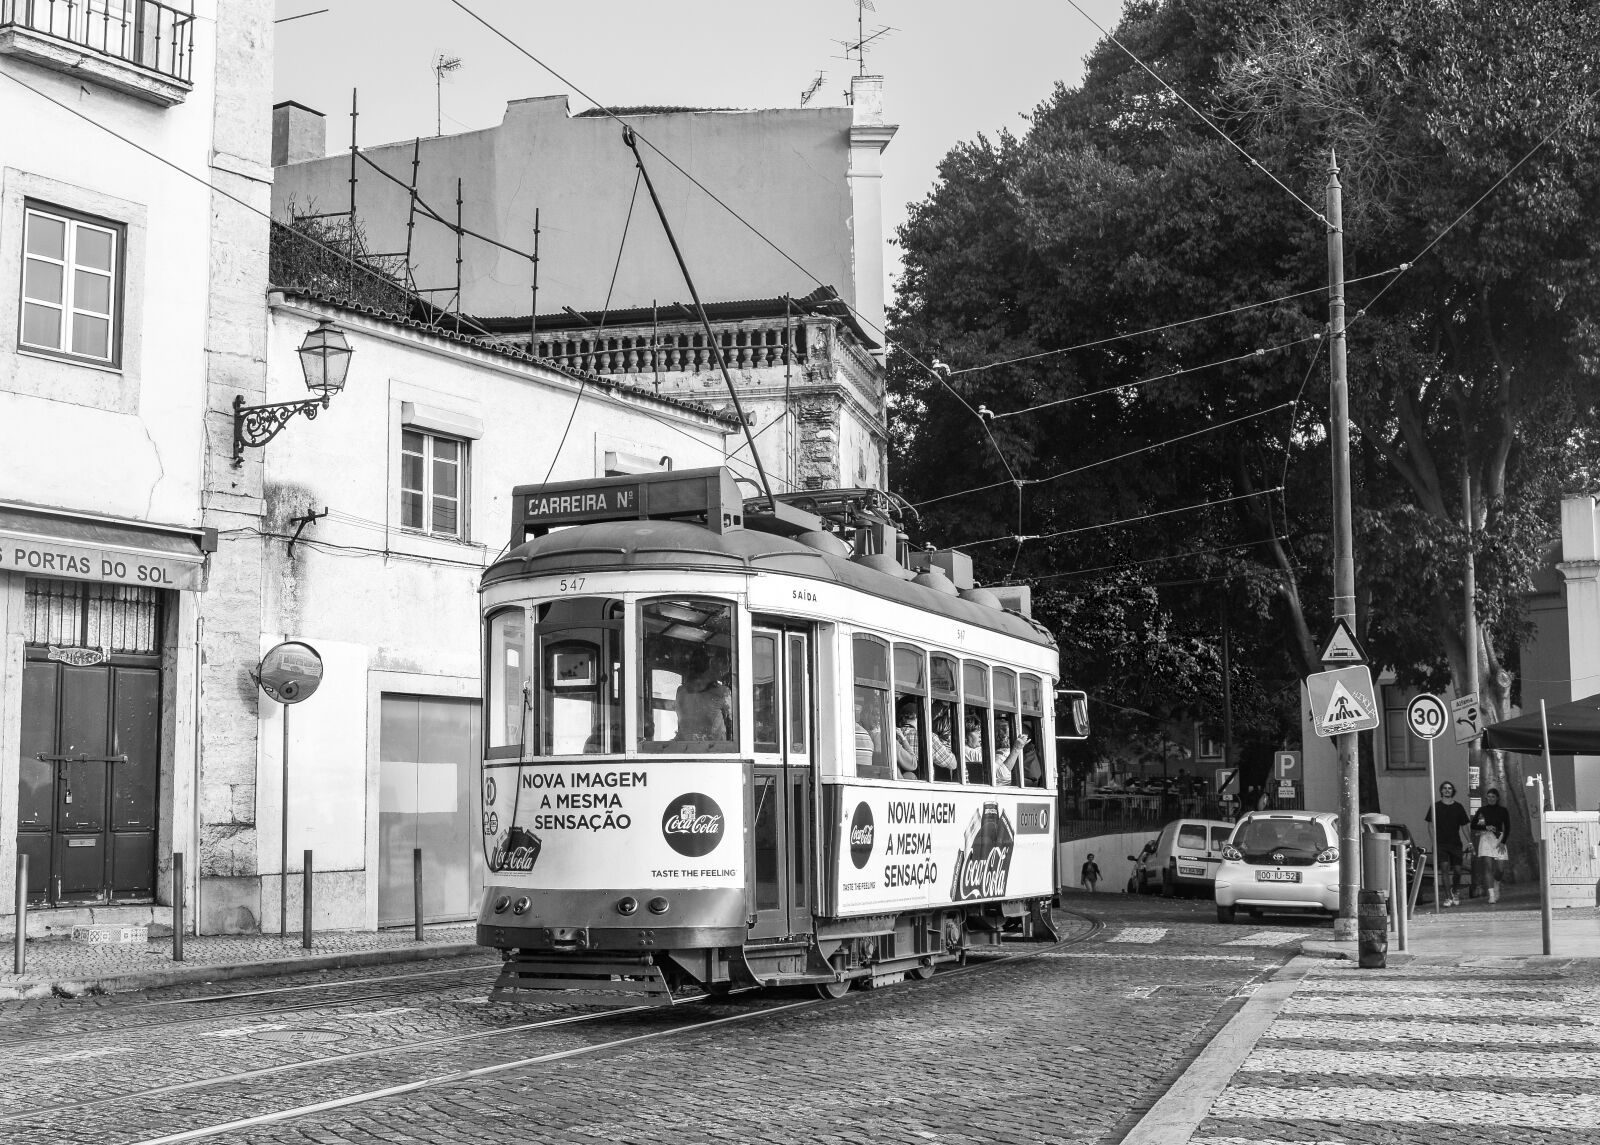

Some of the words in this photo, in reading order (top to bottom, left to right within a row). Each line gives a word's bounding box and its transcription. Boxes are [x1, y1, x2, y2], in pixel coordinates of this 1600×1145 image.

[528, 493, 607, 516] CARREIRA
[15, 548, 91, 574] PORTAS
[101, 559, 127, 578] DO
[137, 564, 173, 584] SOL
[559, 578, 586, 592] 547
[792, 589, 817, 602] SAÍDA
[1413, 707, 1439, 726] 30
[1281, 754, 1295, 777] P
[522, 773, 566, 789] NOVA
[571, 772, 648, 788] IMAGEM
[540, 794, 552, 809] A
[556, 793, 623, 809] MESMA
[887, 801, 917, 824] NOVA
[919, 802, 956, 824] IMAGEM
[535, 810, 632, 833] SENSAÇÃO
[885, 833, 894, 856] A
[896, 833, 932, 855] MESMA
[651, 869, 679, 878] TASTE
[681, 869, 699, 877] THE
[700, 869, 737, 877] FEELING
[884, 857, 938, 889] SENSAÇÃO
